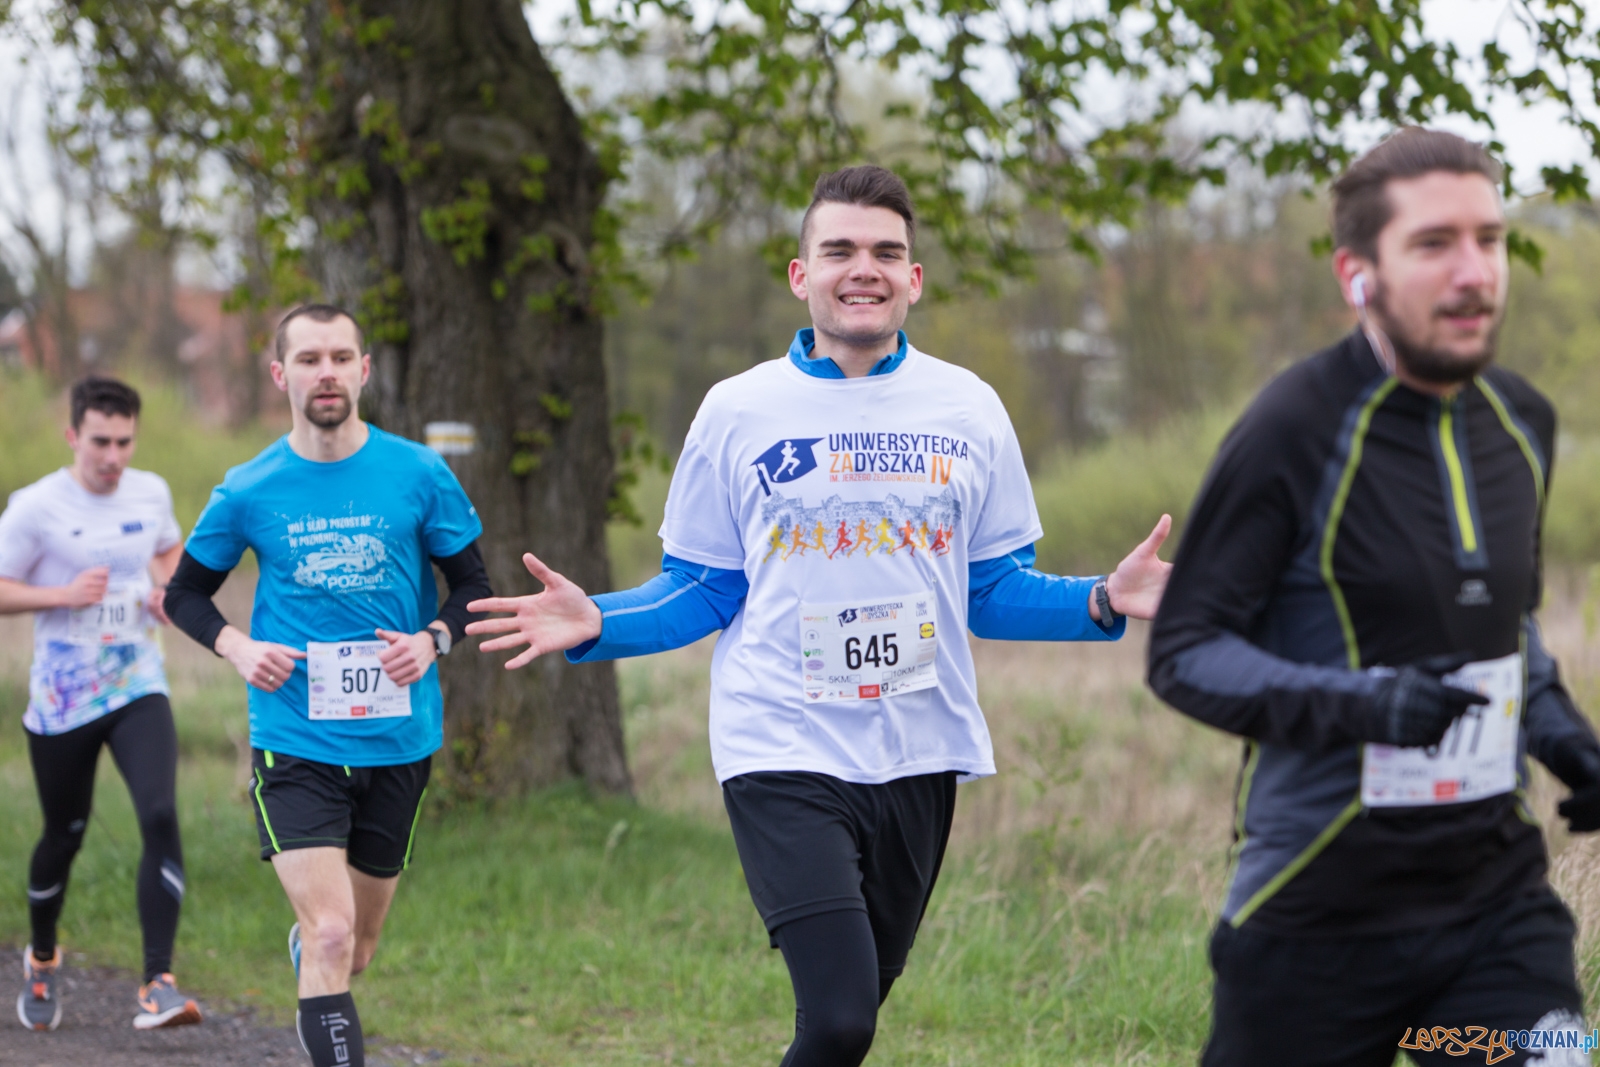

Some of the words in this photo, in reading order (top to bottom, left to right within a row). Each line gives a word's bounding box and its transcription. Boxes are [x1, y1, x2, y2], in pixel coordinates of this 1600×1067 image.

[828, 432, 969, 461] UNIWERSYTECKA
[829, 453, 926, 474] ZADYSZKA
[930, 455, 953, 485] IV
[842, 473, 872, 482] JERZEGO
[859, 602, 904, 614] UNIWERSYTECKA
[845, 633, 899, 670] 645
[341, 668, 381, 694] 507
[828, 675, 850, 684] 5KM
[892, 665, 916, 678] 10KM
